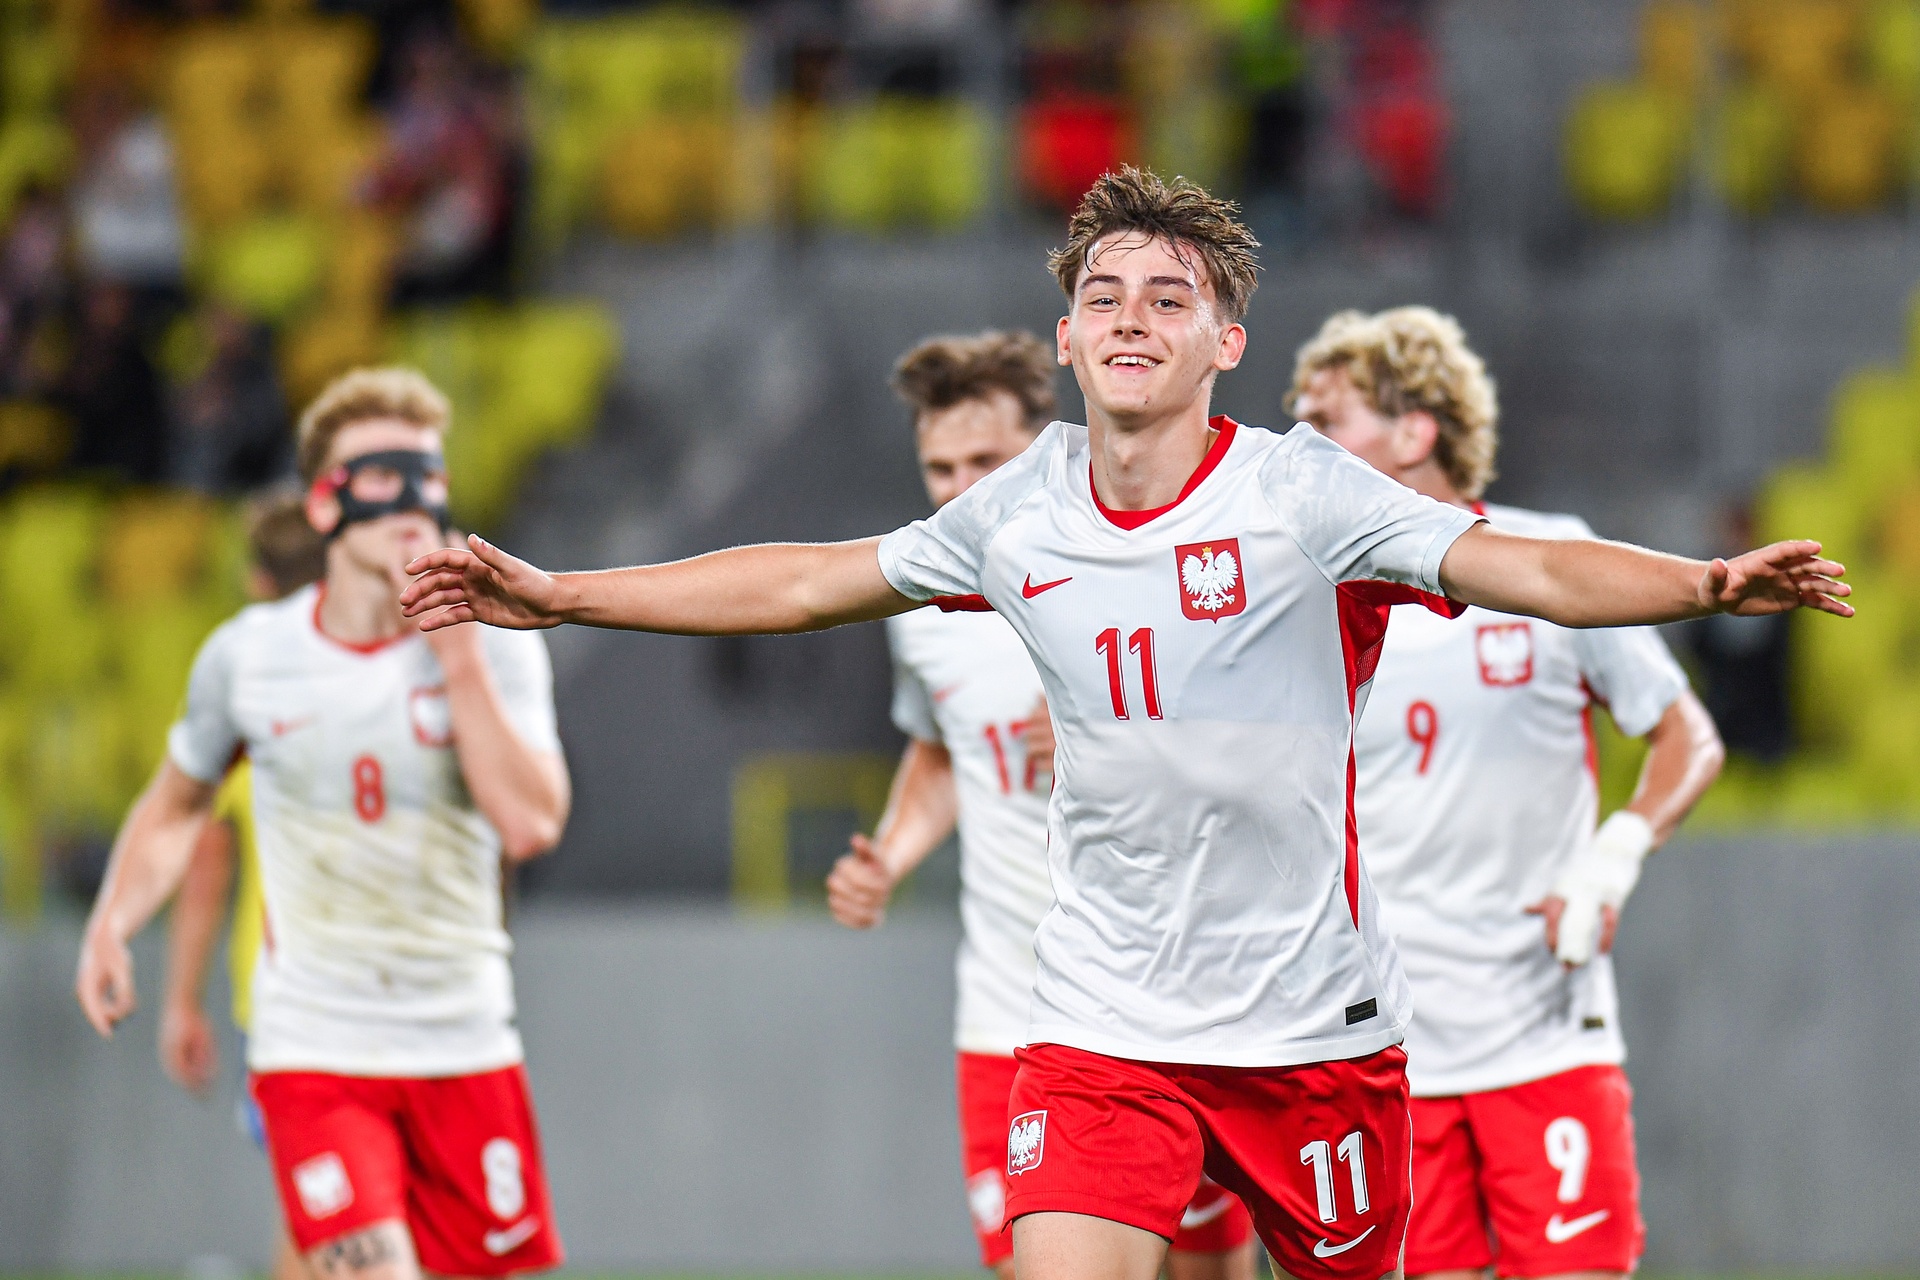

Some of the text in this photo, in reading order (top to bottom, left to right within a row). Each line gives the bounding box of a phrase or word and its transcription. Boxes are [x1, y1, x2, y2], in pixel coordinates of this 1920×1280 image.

[1095, 627, 1163, 720] 11
[1406, 700, 1438, 776] 9
[351, 754, 386, 823] 8
[481, 1137, 525, 1219] 8
[1300, 1131, 1370, 1224] 11
[1544, 1116, 1591, 1203] 9
